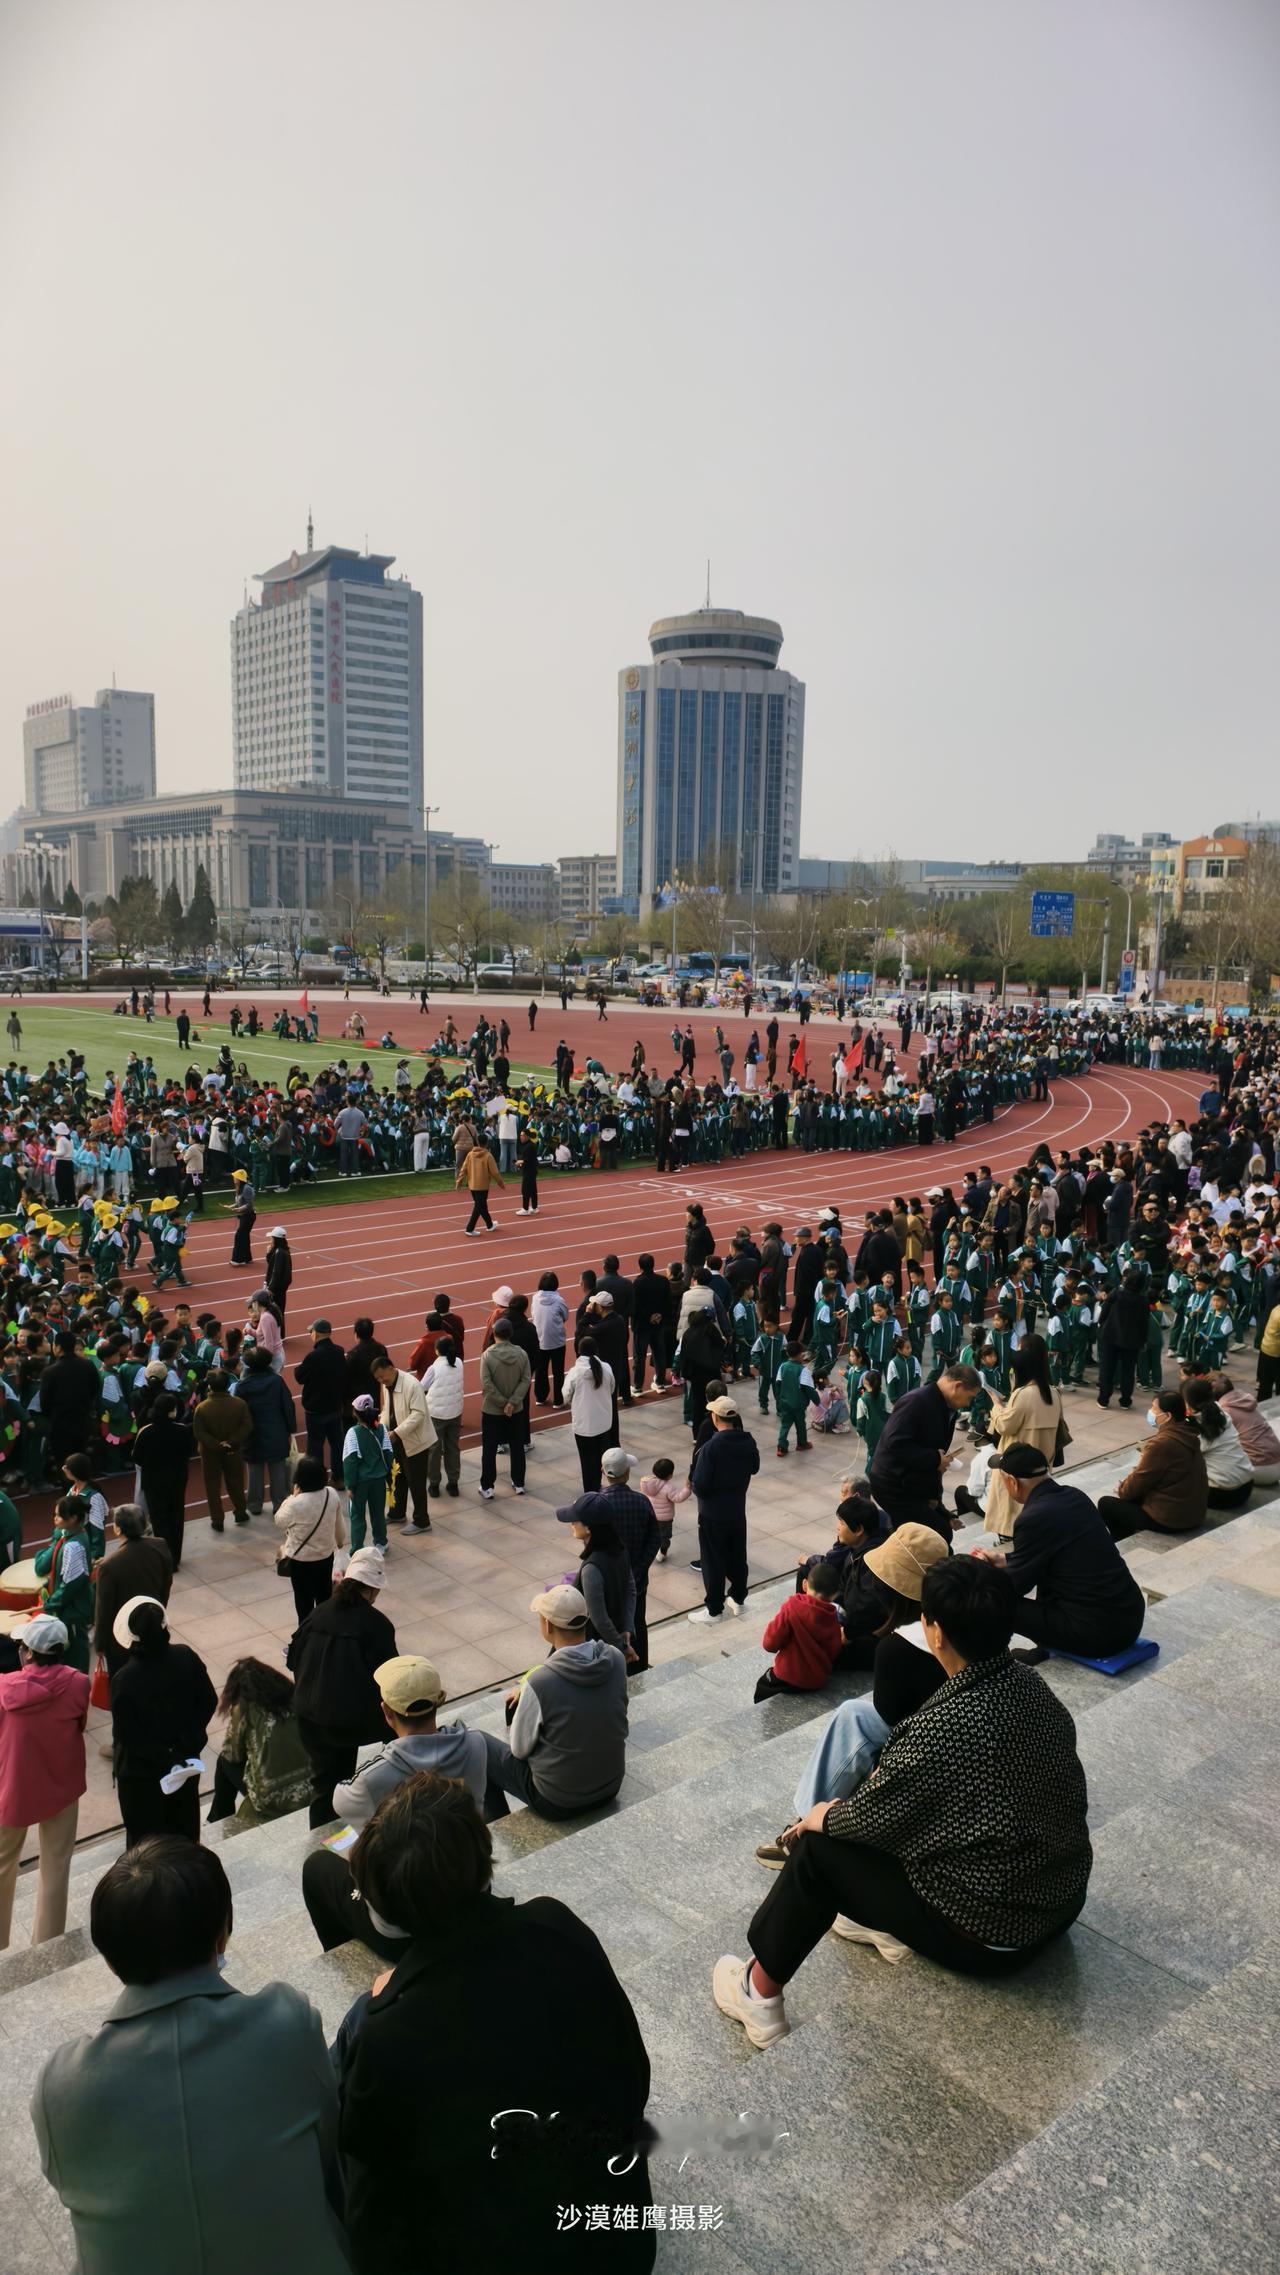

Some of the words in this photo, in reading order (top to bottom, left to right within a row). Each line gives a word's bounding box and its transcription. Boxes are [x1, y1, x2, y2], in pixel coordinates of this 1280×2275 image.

[671, 1189, 706, 1197] 2
[710, 1196, 743, 1204] 3
[757, 1203, 785, 1212] 4
